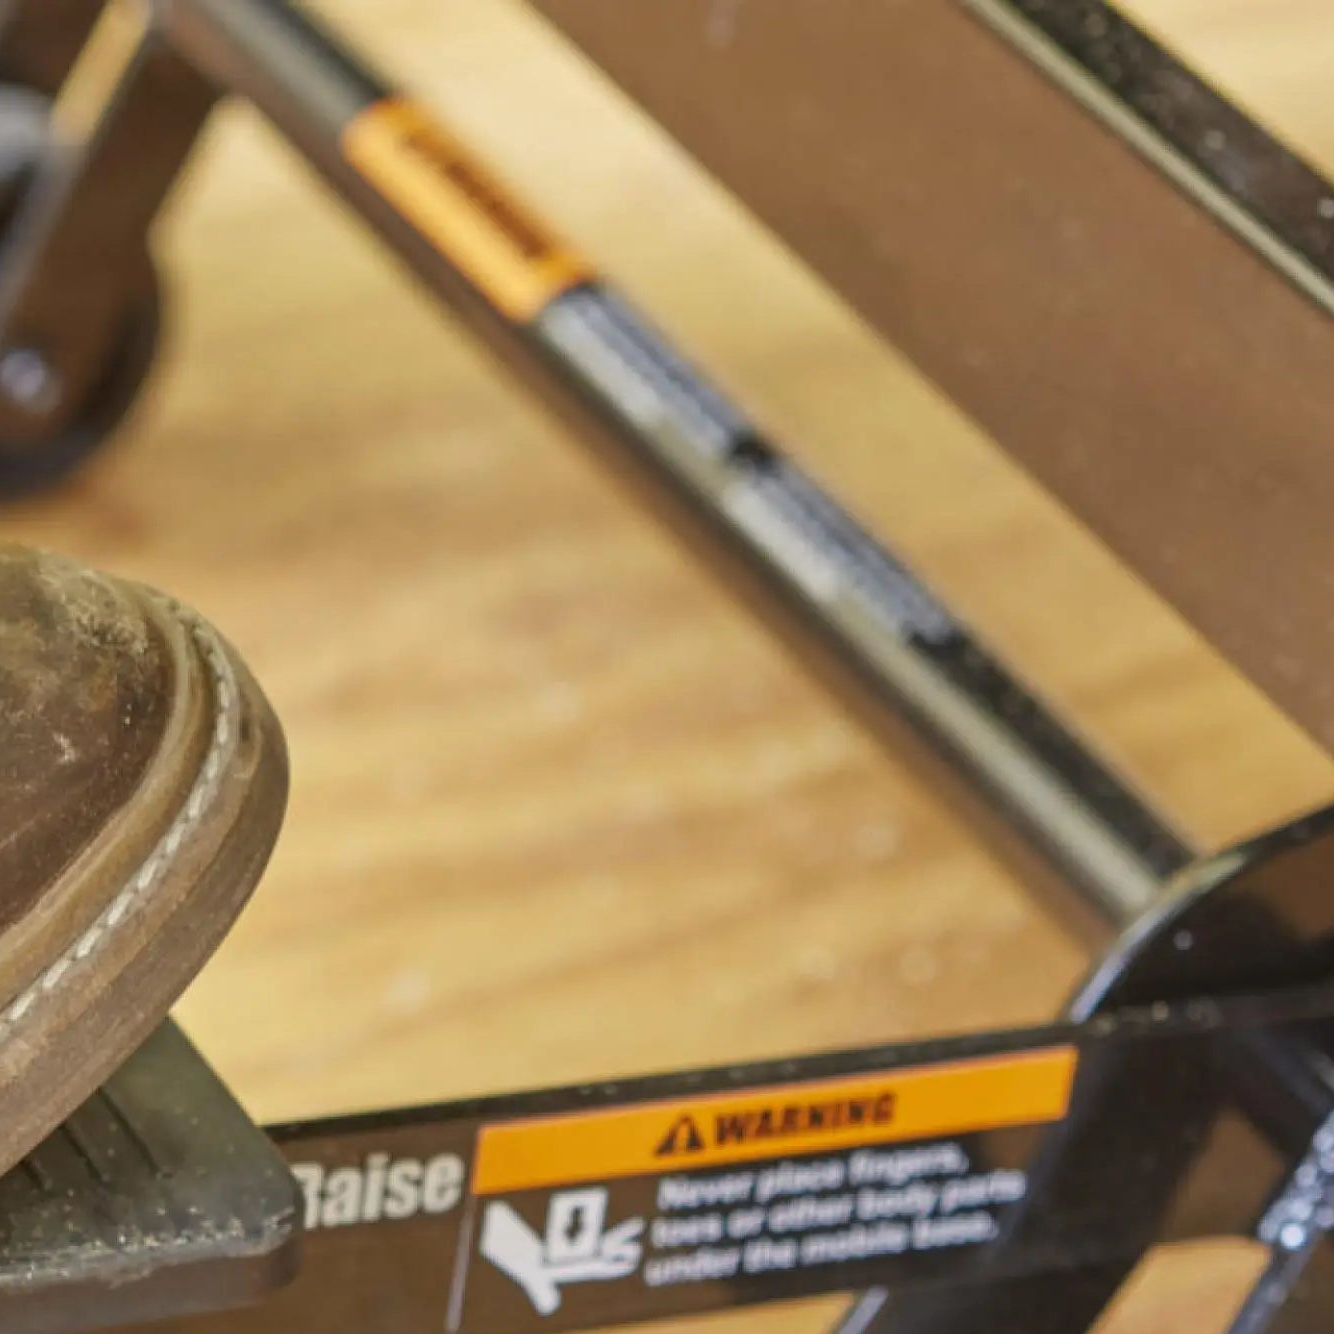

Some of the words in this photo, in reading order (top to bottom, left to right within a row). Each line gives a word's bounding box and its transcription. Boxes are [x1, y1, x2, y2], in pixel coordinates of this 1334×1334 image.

[714, 1092, 896, 1144] WARNING
[657, 1170, 753, 1211] Never
[755, 1158, 846, 1203] place
[727, 1207, 765, 1239] or
[768, 1195, 855, 1234] other
[857, 1182, 939, 1221] body
[940, 1168, 1028, 1215] parts
[644, 1246, 741, 1286] under
[744, 1236, 798, 1274] the
[800, 1219, 908, 1267] mobile
